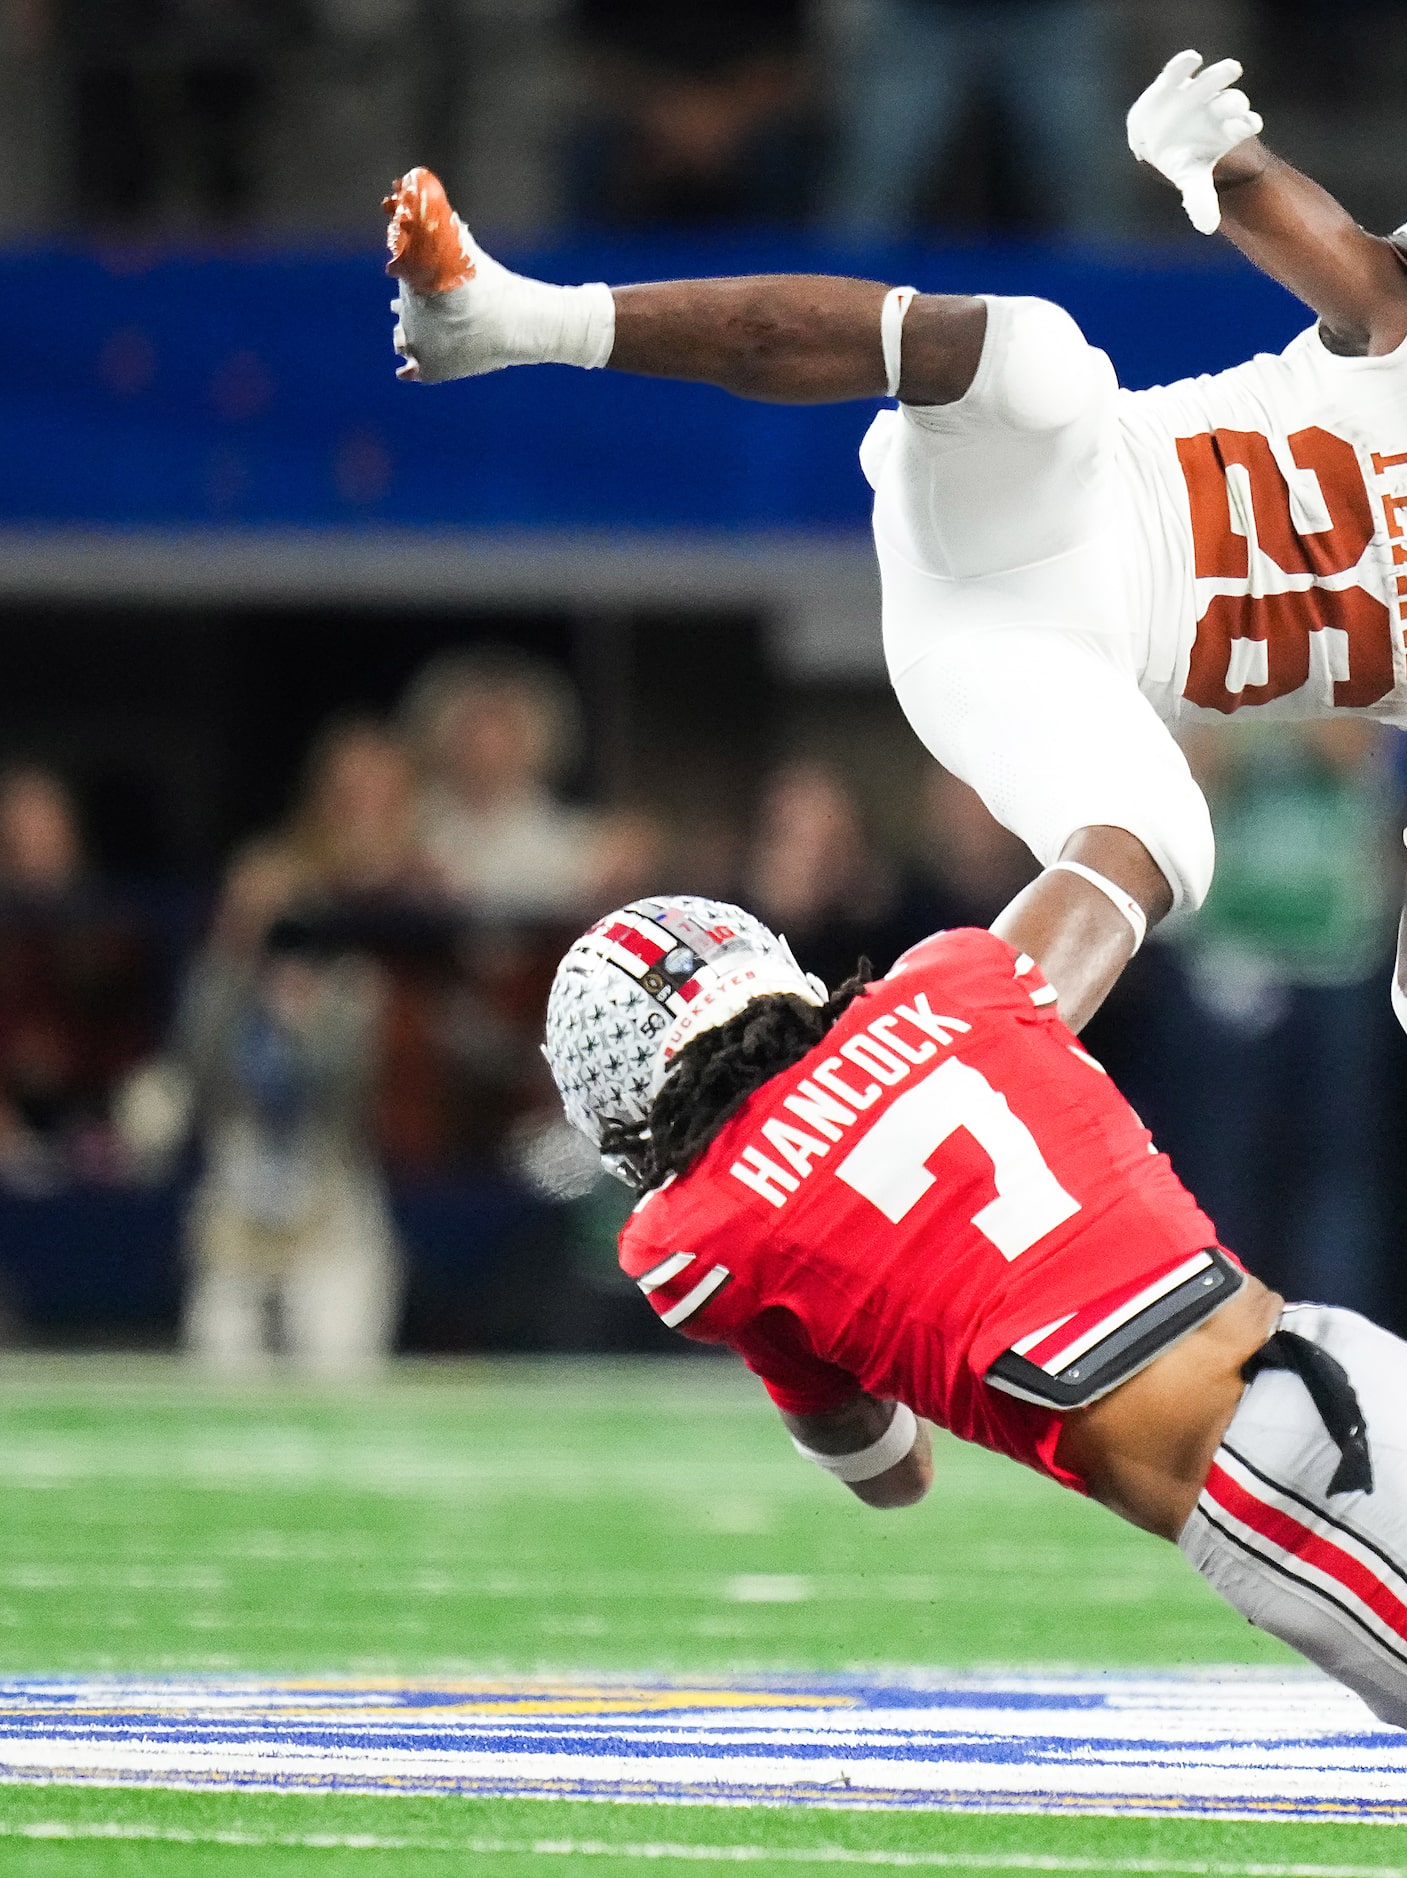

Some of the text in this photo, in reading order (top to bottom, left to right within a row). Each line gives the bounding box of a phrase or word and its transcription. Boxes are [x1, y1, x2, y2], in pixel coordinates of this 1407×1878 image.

[1175, 425, 1396, 714] 26
[640, 1012, 666, 1040] 50
[664, 970, 756, 1059] BUCKEYES
[730, 992, 972, 1208] HANCOCK
[834, 1055, 1082, 1262] 7
